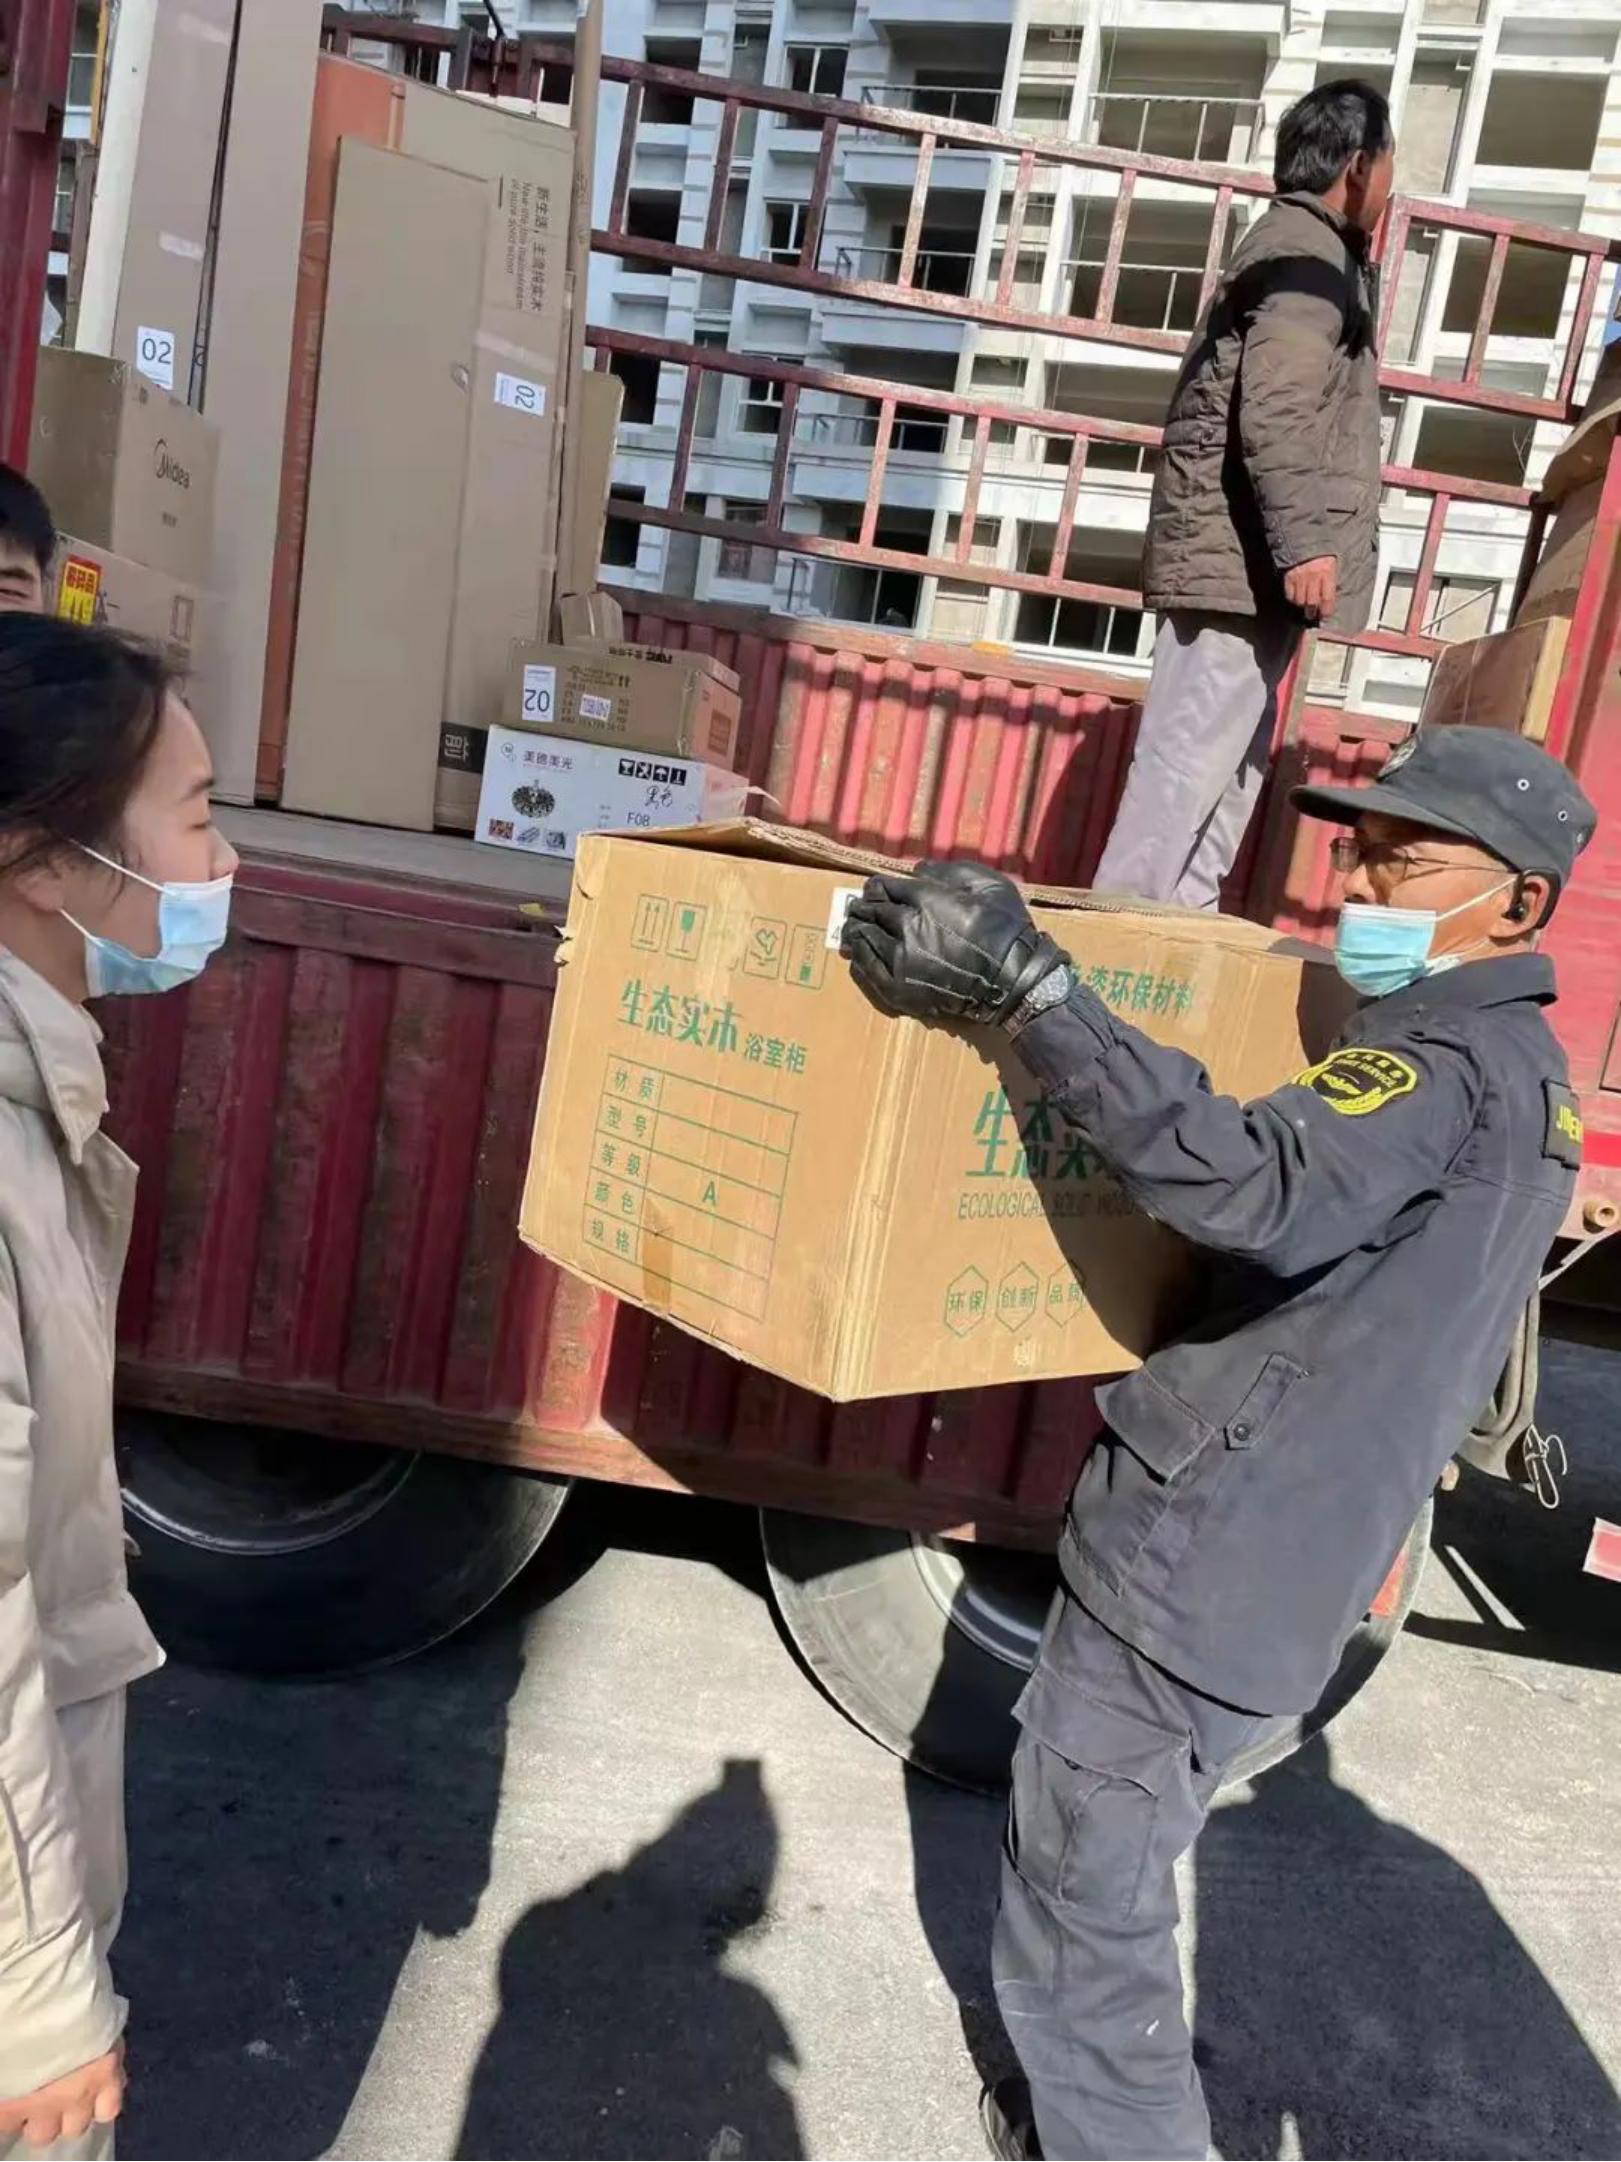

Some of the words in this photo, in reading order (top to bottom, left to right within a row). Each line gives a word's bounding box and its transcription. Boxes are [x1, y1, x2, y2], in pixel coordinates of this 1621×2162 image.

[141, 338, 172, 365] 02
[514, 385, 535, 409] 02
[524, 689, 550, 712] 02
[1071, 961, 1193, 1016] 漆环保材料
[617, 978, 743, 1052] 生态实木
[743, 1031, 808, 1075] 浴室柜
[702, 1180, 718, 1207] A
